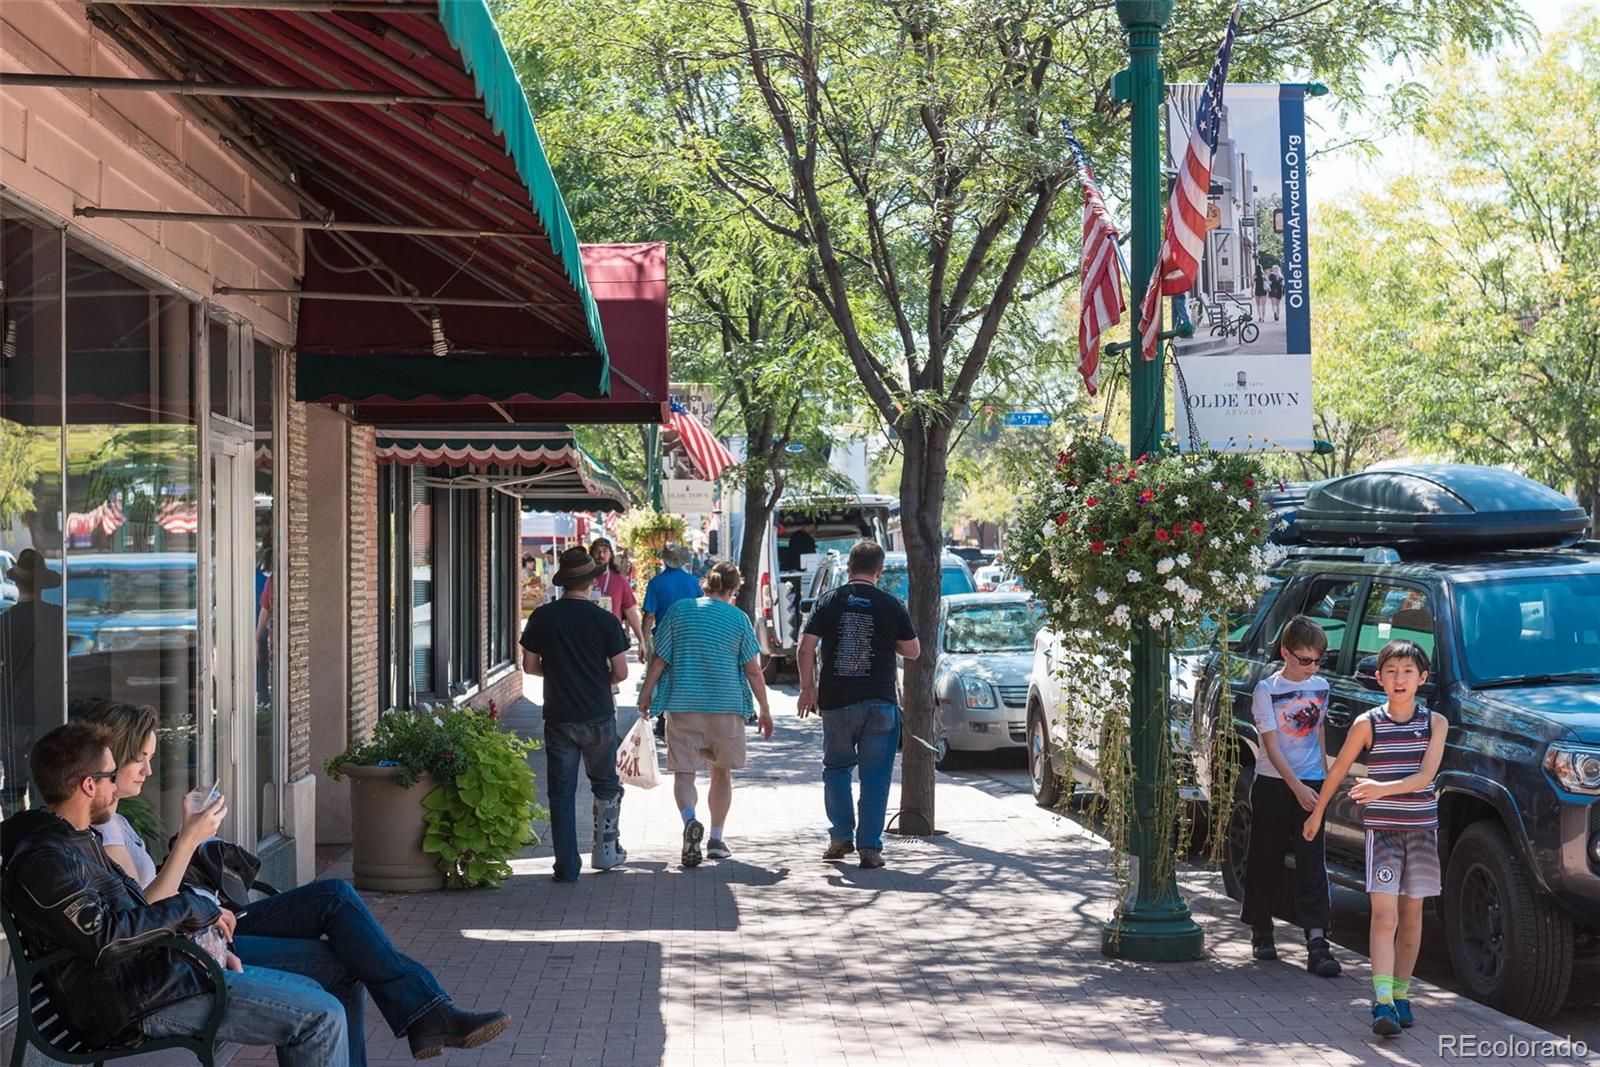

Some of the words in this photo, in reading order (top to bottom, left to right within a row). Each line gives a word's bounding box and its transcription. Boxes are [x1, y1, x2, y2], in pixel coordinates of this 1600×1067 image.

[1285, 134, 1303, 308] OldeTownArvada.Org
[1187, 394, 1239, 408] OLDE
[1245, 392, 1299, 407] TOWN
[1224, 408, 1264, 416] ARVADA
